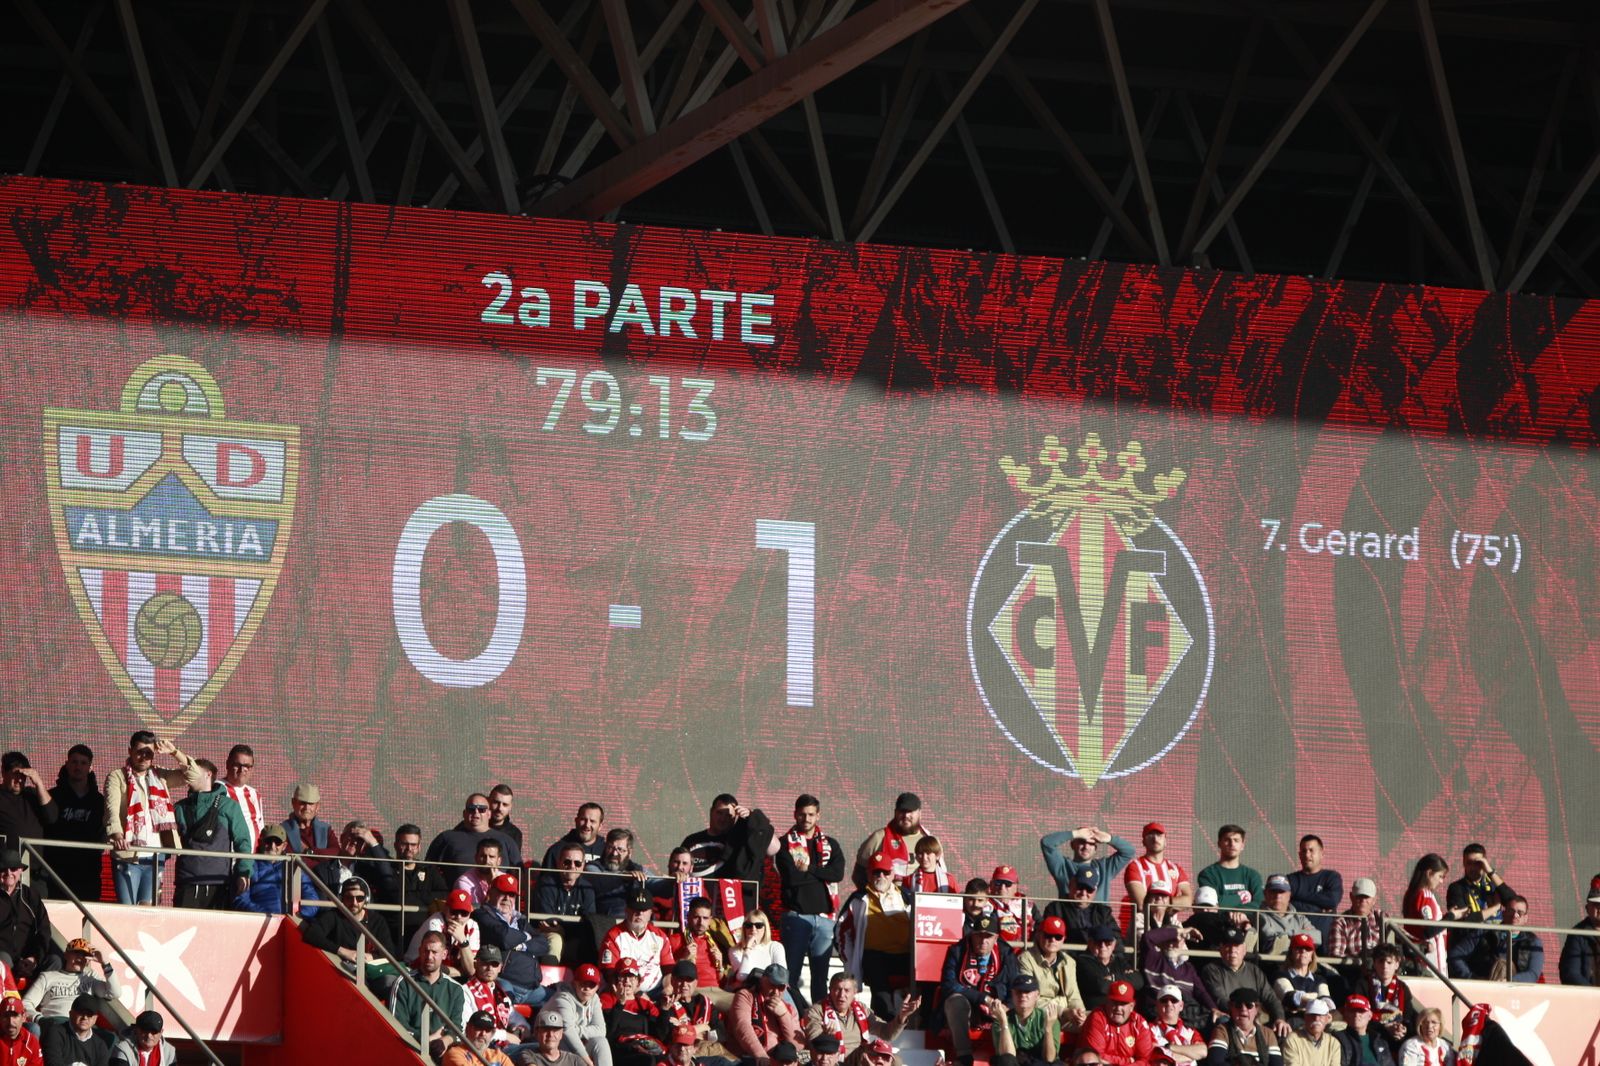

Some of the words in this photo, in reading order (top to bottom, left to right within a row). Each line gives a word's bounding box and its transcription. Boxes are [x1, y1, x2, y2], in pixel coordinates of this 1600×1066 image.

[481, 271, 550, 327] 2a
[573, 280, 776, 345] PARTE
[536, 367, 718, 441] 79:13
[76, 513, 264, 556] ALMERIA
[1261, 518, 1287, 551] 7.
[1299, 522, 1420, 561] Gerard
[1451, 529, 1522, 574] (75')
[392, 493, 527, 688] 0
[755, 518, 816, 708] 1
[917, 921, 943, 937] 134
